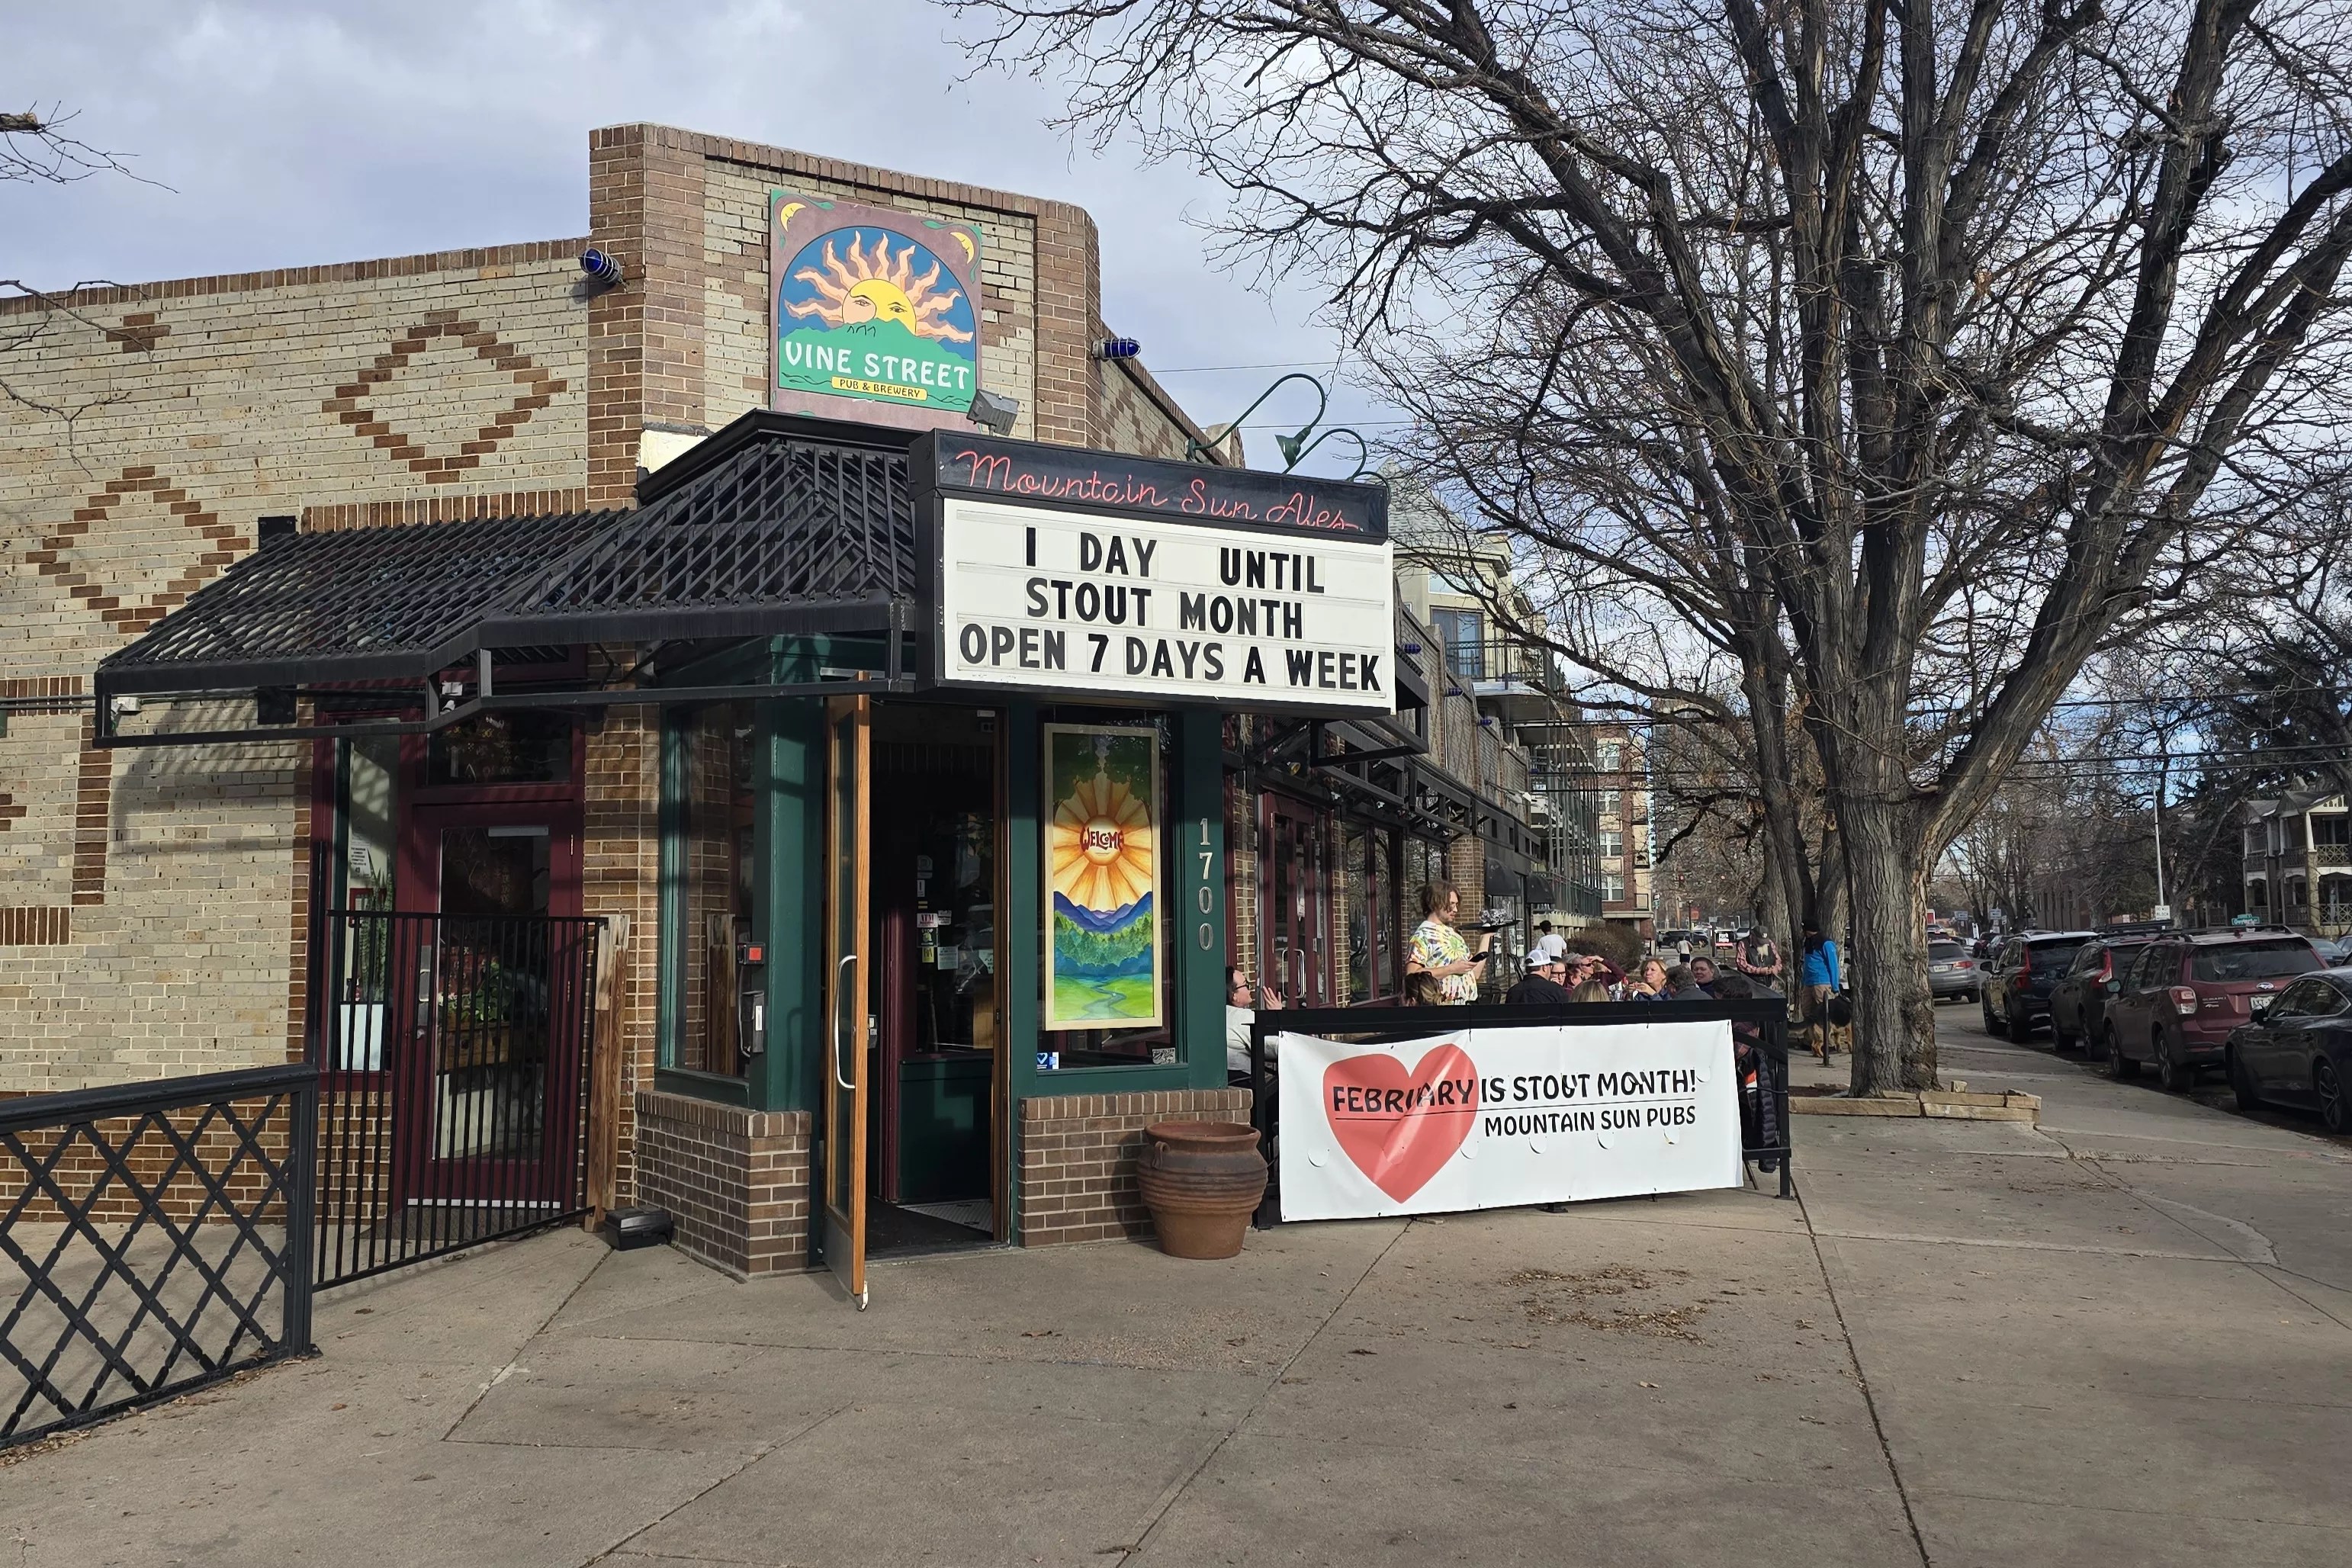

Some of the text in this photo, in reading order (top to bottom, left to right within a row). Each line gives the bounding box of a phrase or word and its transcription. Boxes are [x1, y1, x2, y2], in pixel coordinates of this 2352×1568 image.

[785, 340, 970, 390] VINE STREET
[840, 379, 921, 398] PUB & BREWERY
[956, 450, 1364, 531] Mountain Sun Ales
[1080, 532, 1158, 578] DAY
[1220, 547, 1325, 594] UNTIL
[1026, 577, 1303, 640] STOUT MONTH
[959, 623, 1381, 692] OPEN 7 DAYS A WEEK
[1079, 827, 1125, 852] WELCOME
[1198, 818, 1213, 951] 1700
[1481, 1077, 1507, 1103] IS
[1513, 1074, 1591, 1102] STOUT
[1597, 1069, 1695, 1097] MONTH!
[1485, 1105, 1695, 1137] MOUNTAIN SUN PUBS
